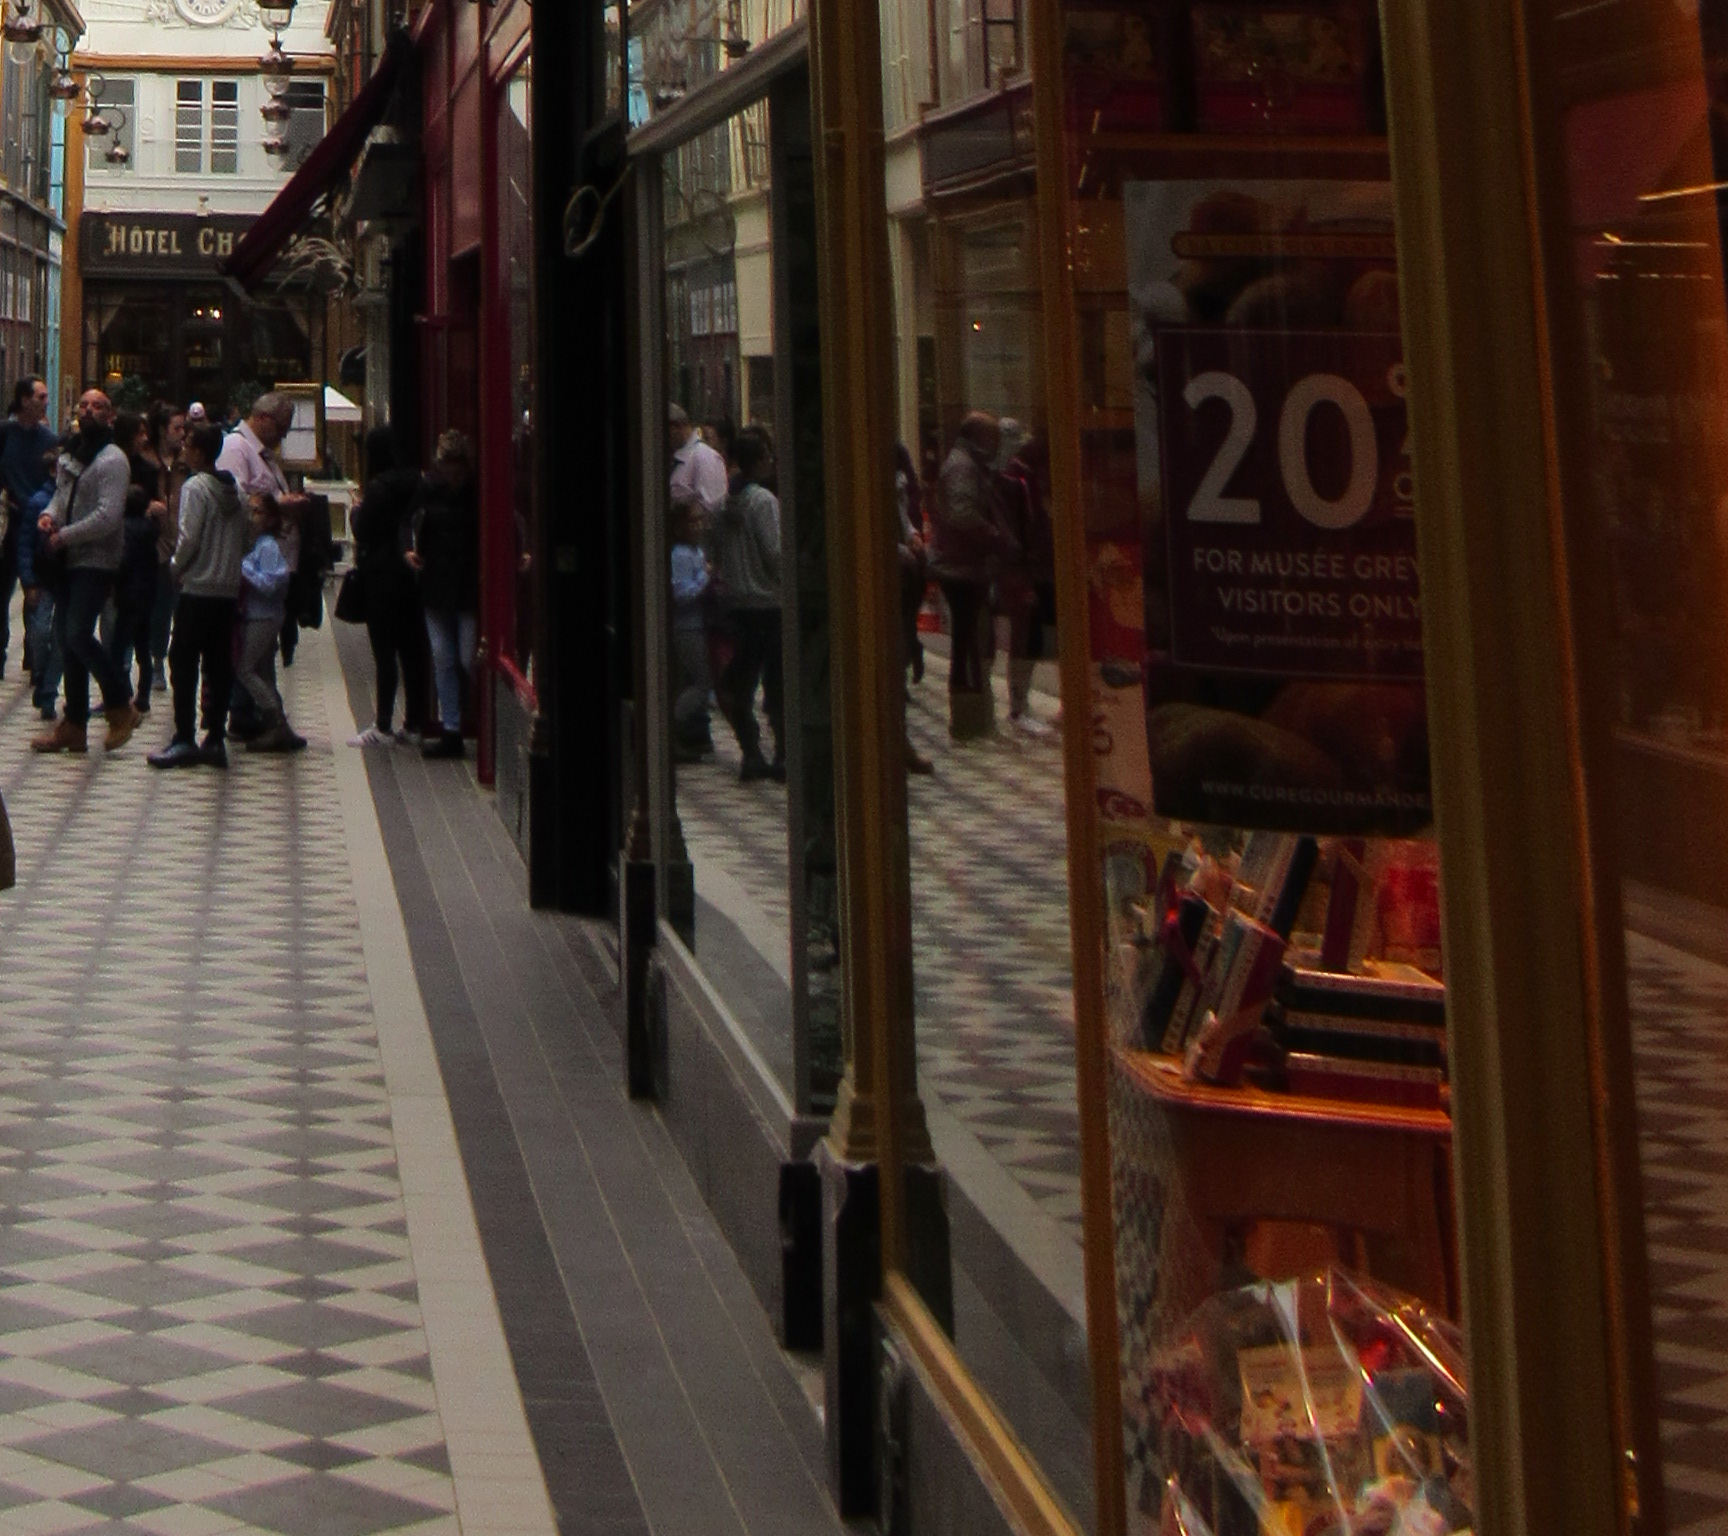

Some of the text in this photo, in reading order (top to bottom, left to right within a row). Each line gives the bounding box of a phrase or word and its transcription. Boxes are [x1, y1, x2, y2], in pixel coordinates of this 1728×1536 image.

[104, 222, 182, 255] HÔTEL
[1193, 548, 1243, 573] FOR
[1249, 546, 1346, 578] MUSÉE
[1217, 586, 1424, 620] VISITORS ONLY
